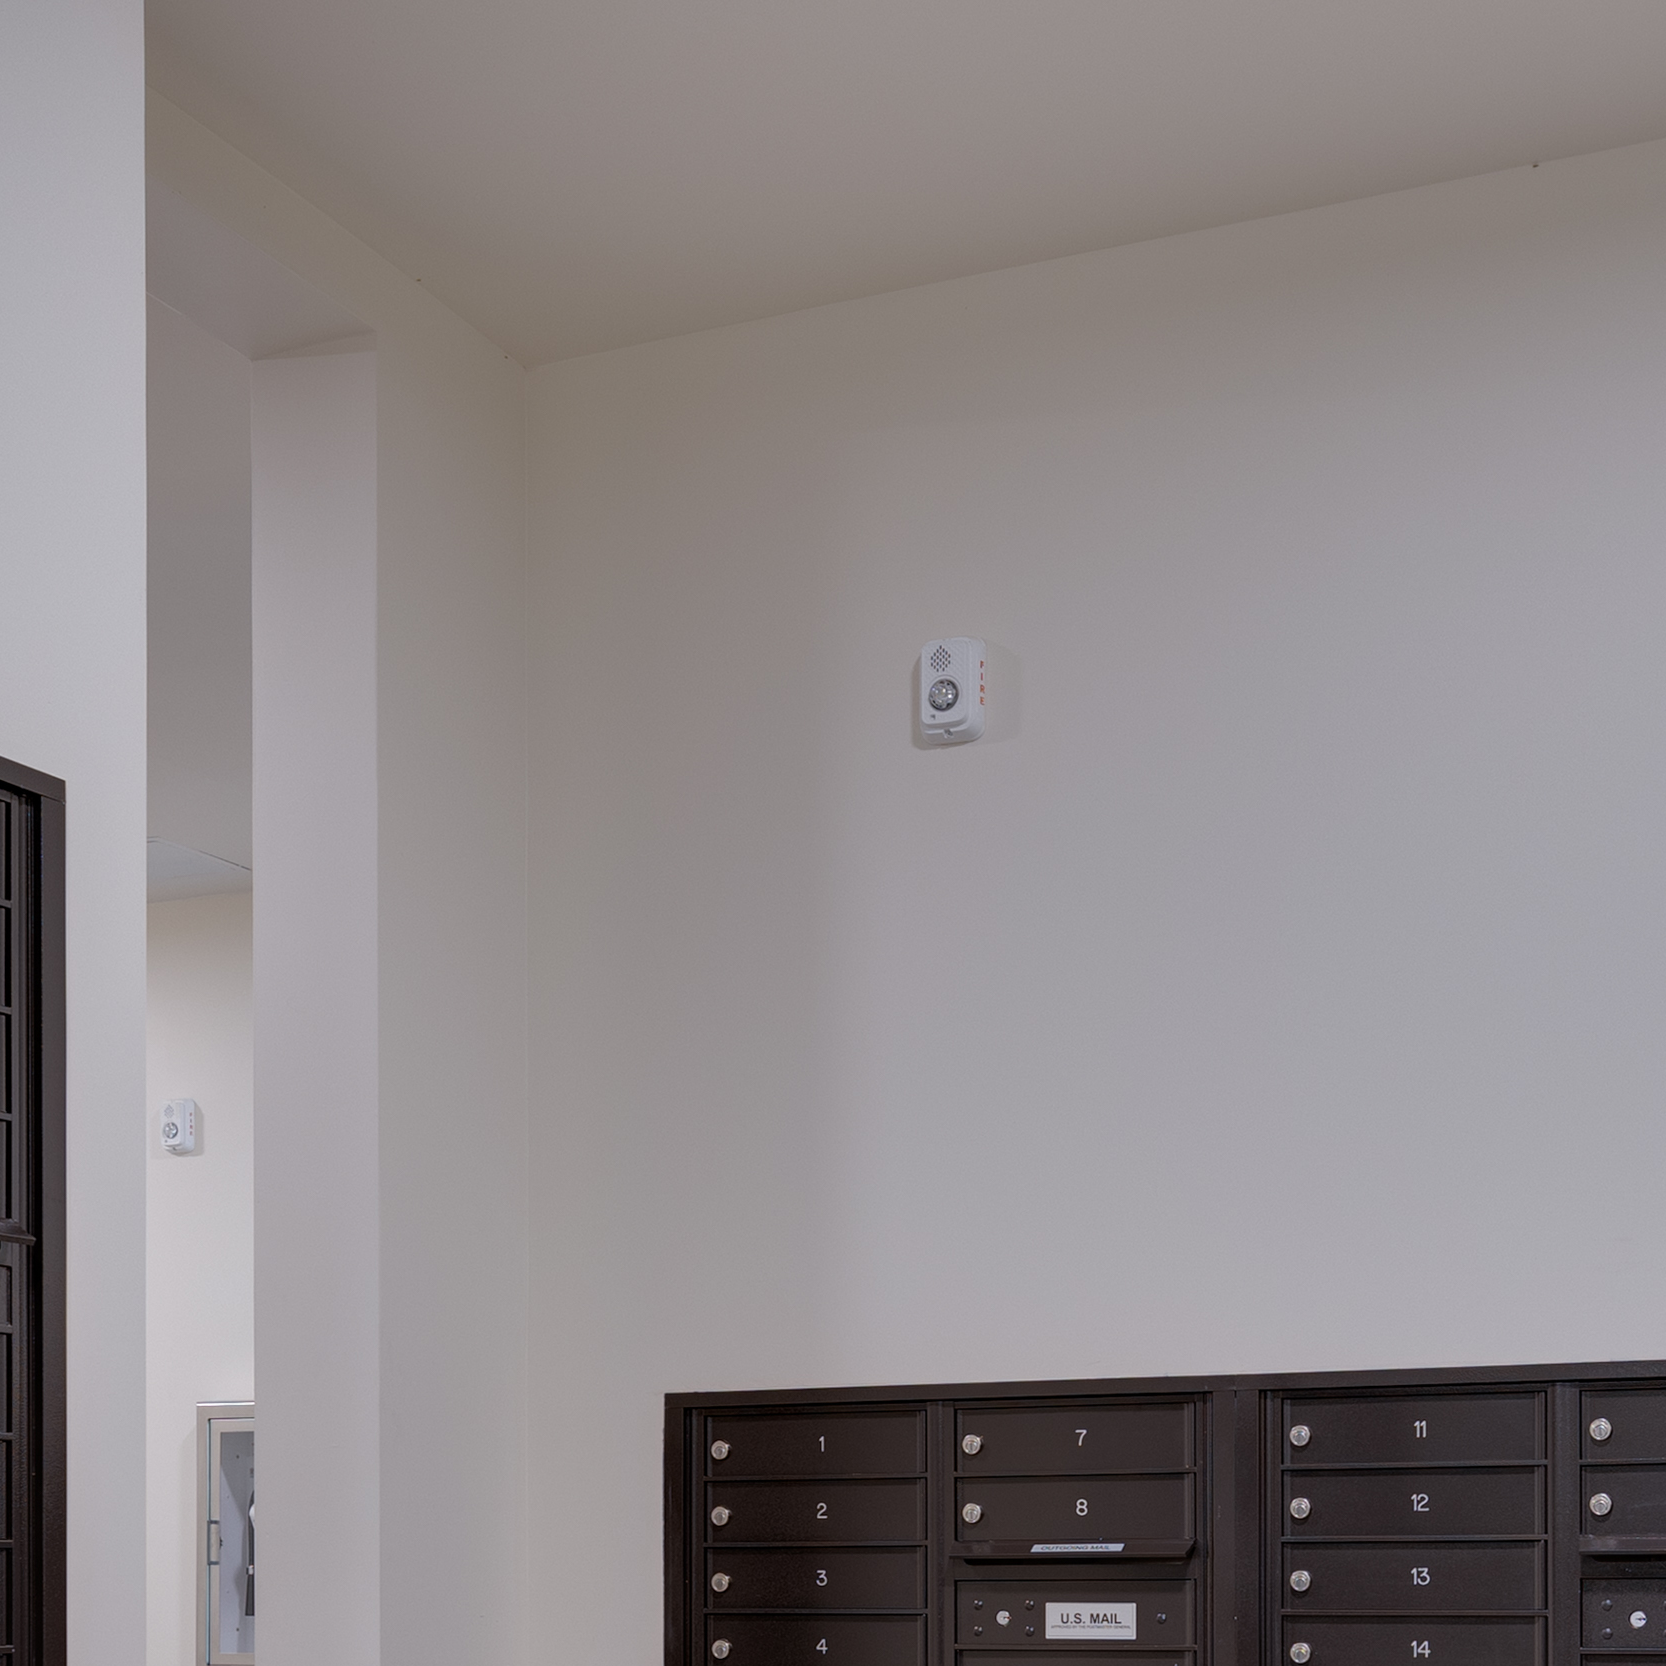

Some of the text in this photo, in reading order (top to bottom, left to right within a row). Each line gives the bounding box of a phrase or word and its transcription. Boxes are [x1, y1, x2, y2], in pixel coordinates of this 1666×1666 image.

[1075, 1429, 1088, 1447] 7
[1413, 1420, 1427, 1438] 11
[818, 1435, 825, 1453] 1
[816, 1502, 828, 1519] 2
[1075, 1498, 1088, 1516] 8
[1410, 1493, 1430, 1512] 12
[816, 1569, 828, 1587] 3
[1410, 1567, 1431, 1586] 13
[1060, 1612, 1123, 1625] U.S. MAIL
[815, 1638, 828, 1655] 4
[1410, 1640, 1431, 1658] 14
